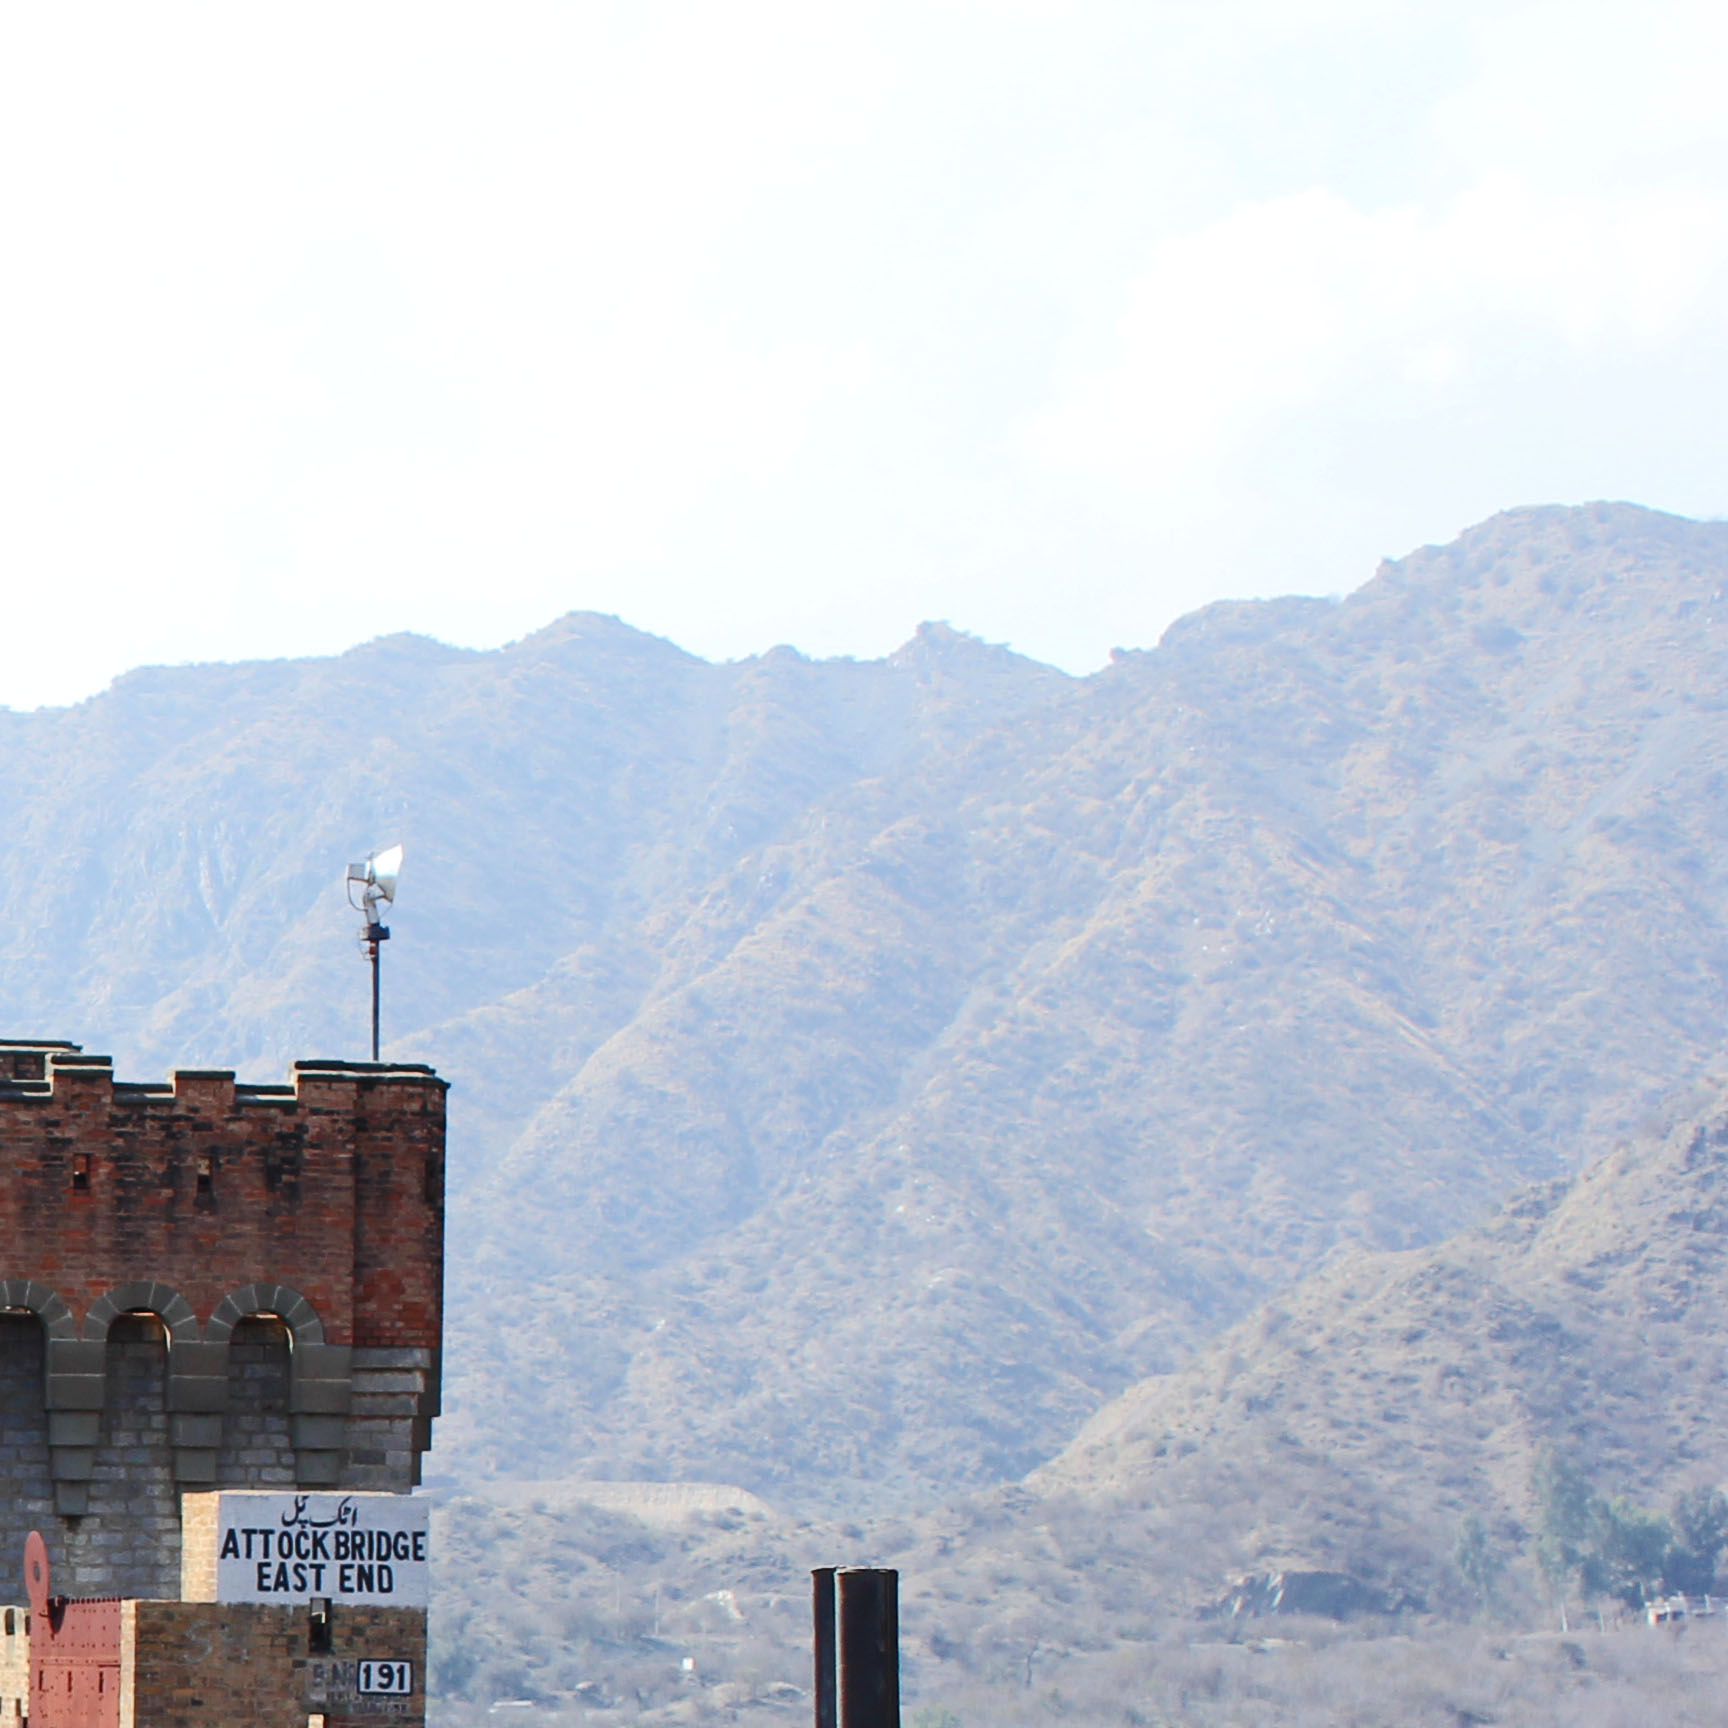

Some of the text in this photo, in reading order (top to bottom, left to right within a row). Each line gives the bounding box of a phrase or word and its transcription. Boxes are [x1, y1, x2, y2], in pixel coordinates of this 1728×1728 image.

[219, 1528, 427, 1561] ATTOCK BRIDGE
[256, 1562, 394, 1594] EAST END
[363, 1664, 406, 1691] 191
